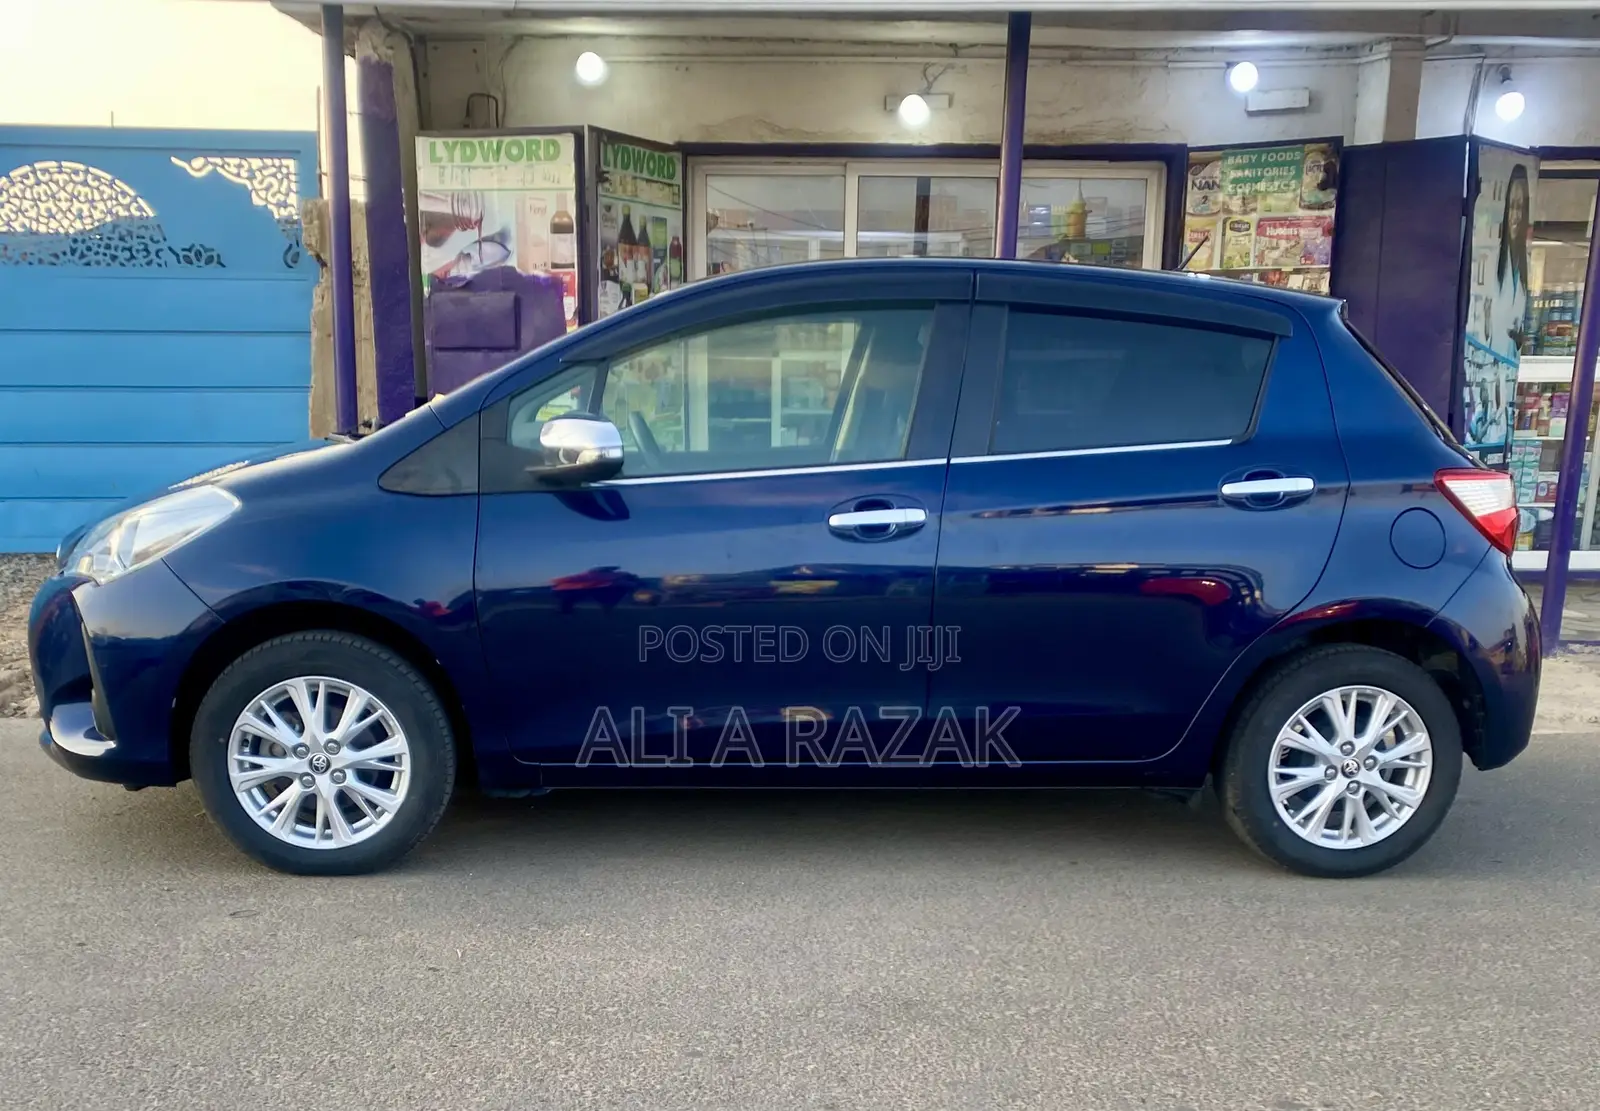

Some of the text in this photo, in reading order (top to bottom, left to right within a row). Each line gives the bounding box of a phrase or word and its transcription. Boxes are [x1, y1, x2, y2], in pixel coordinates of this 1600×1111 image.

[429, 138, 562, 164] LYDWORD
[1228, 151, 1301, 165] BABY FOODS
[603, 142, 677, 181] LYDWORD
[1191, 179, 1220, 190] NAN
